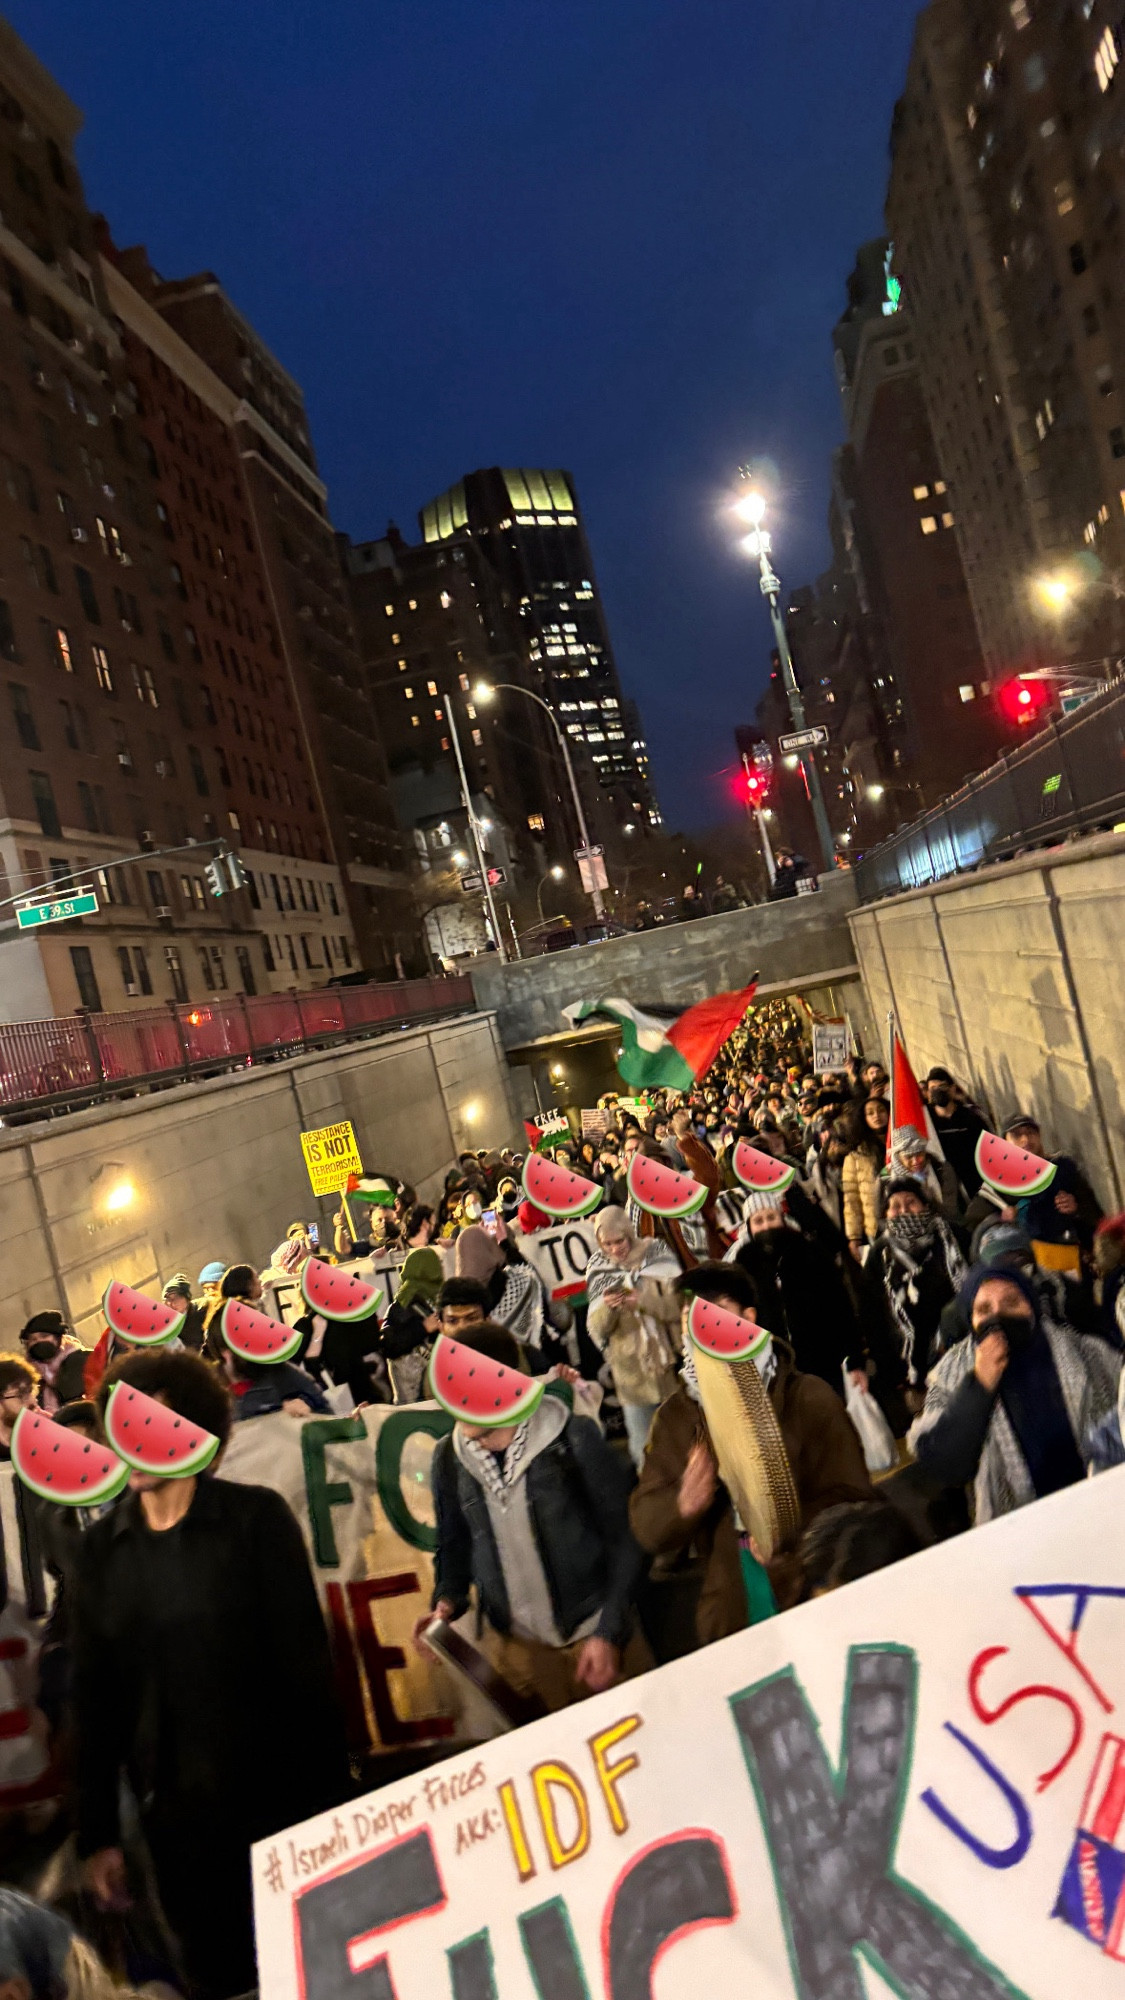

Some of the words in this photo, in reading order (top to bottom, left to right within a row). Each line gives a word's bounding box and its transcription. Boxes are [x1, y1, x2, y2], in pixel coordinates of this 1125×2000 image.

[39, 908, 47, 920] E
[64, 902, 74, 914] St
[534, 1108, 560, 1127] FREE
[302, 1122, 350, 1144] RESISTANCE
[306, 1144, 322, 1162] IS
[324, 1135, 352, 1159] NOT
[311, 1156, 360, 1177] TERRORISM!
[539, 1231, 592, 1282] TO
[919, 1583, 1125, 1870] USA
[353, 1795, 417, 1840] Diaper
[423, 1761, 486, 1811] Forces
[456, 1808, 500, 1855] AKA:
[496, 1713, 644, 1883] IDF
